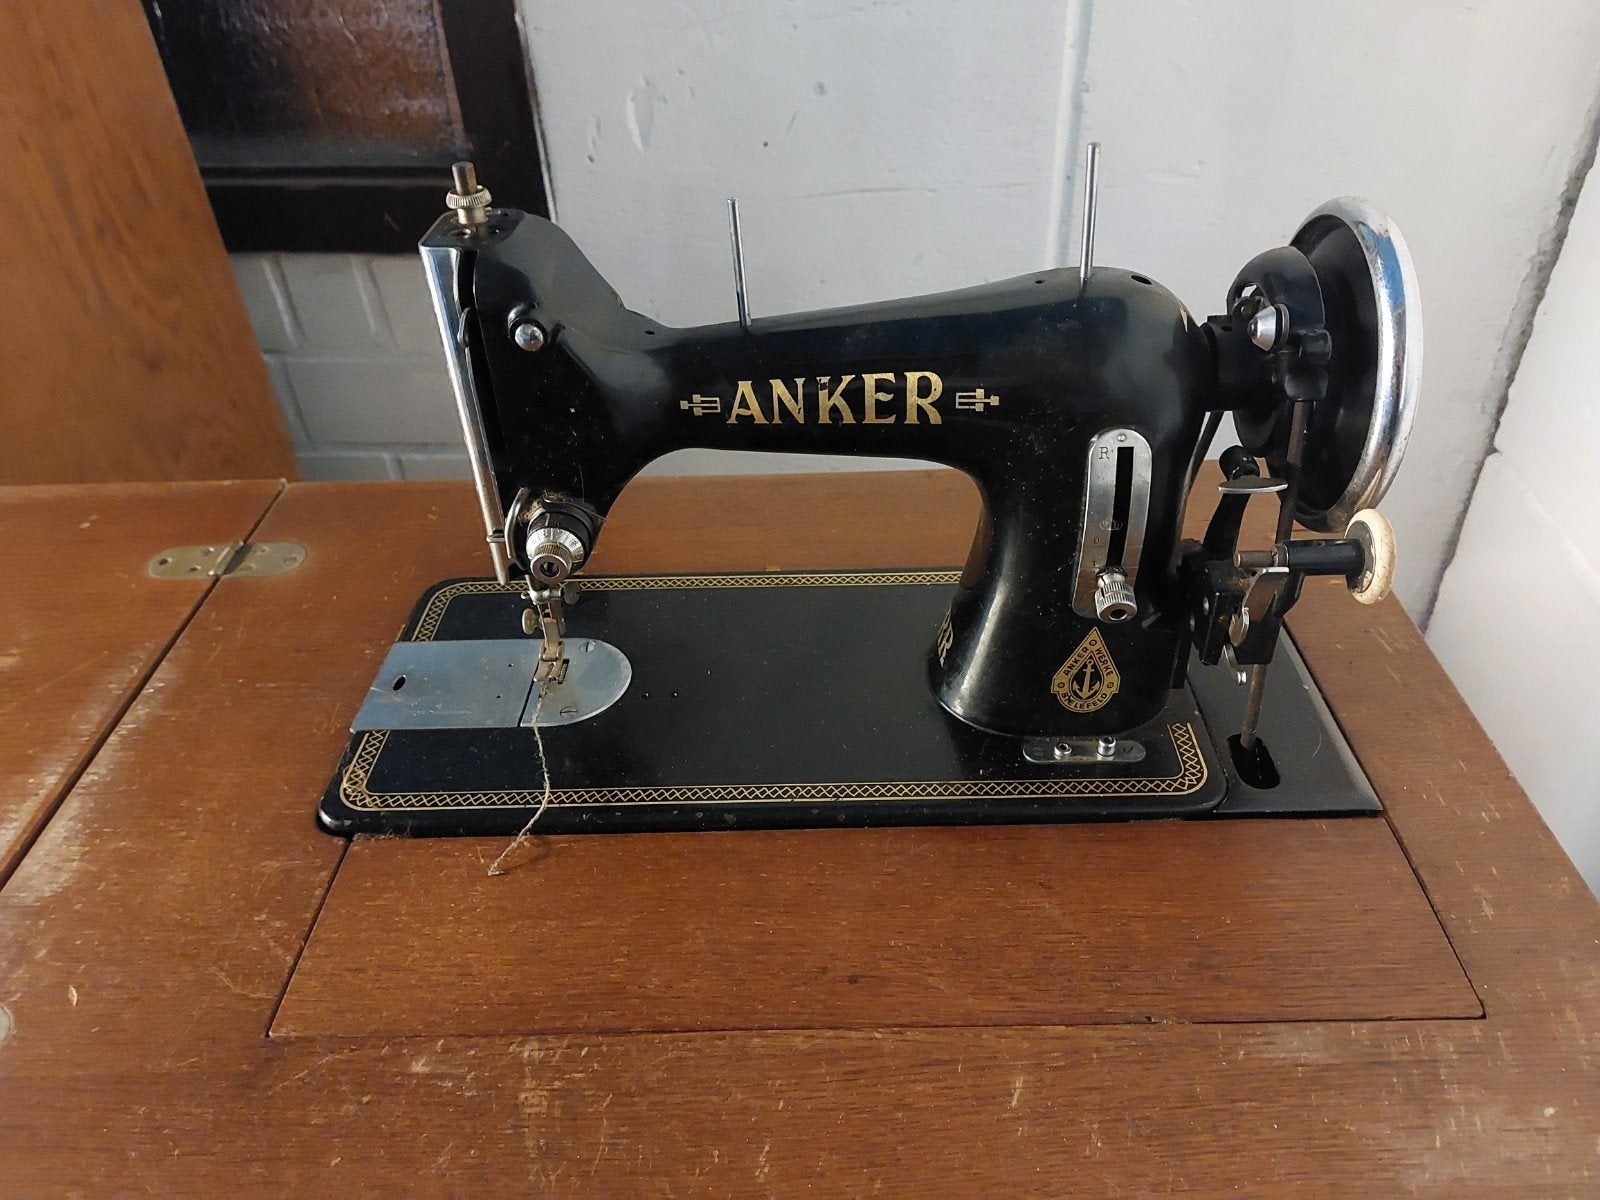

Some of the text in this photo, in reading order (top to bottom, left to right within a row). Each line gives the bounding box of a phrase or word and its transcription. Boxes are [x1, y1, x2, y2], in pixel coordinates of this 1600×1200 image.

[726, 371, 943, 425] ANKER
[1098, 446, 1110, 460] R
[1063, 646, 1113, 676] ANKER WERKE
